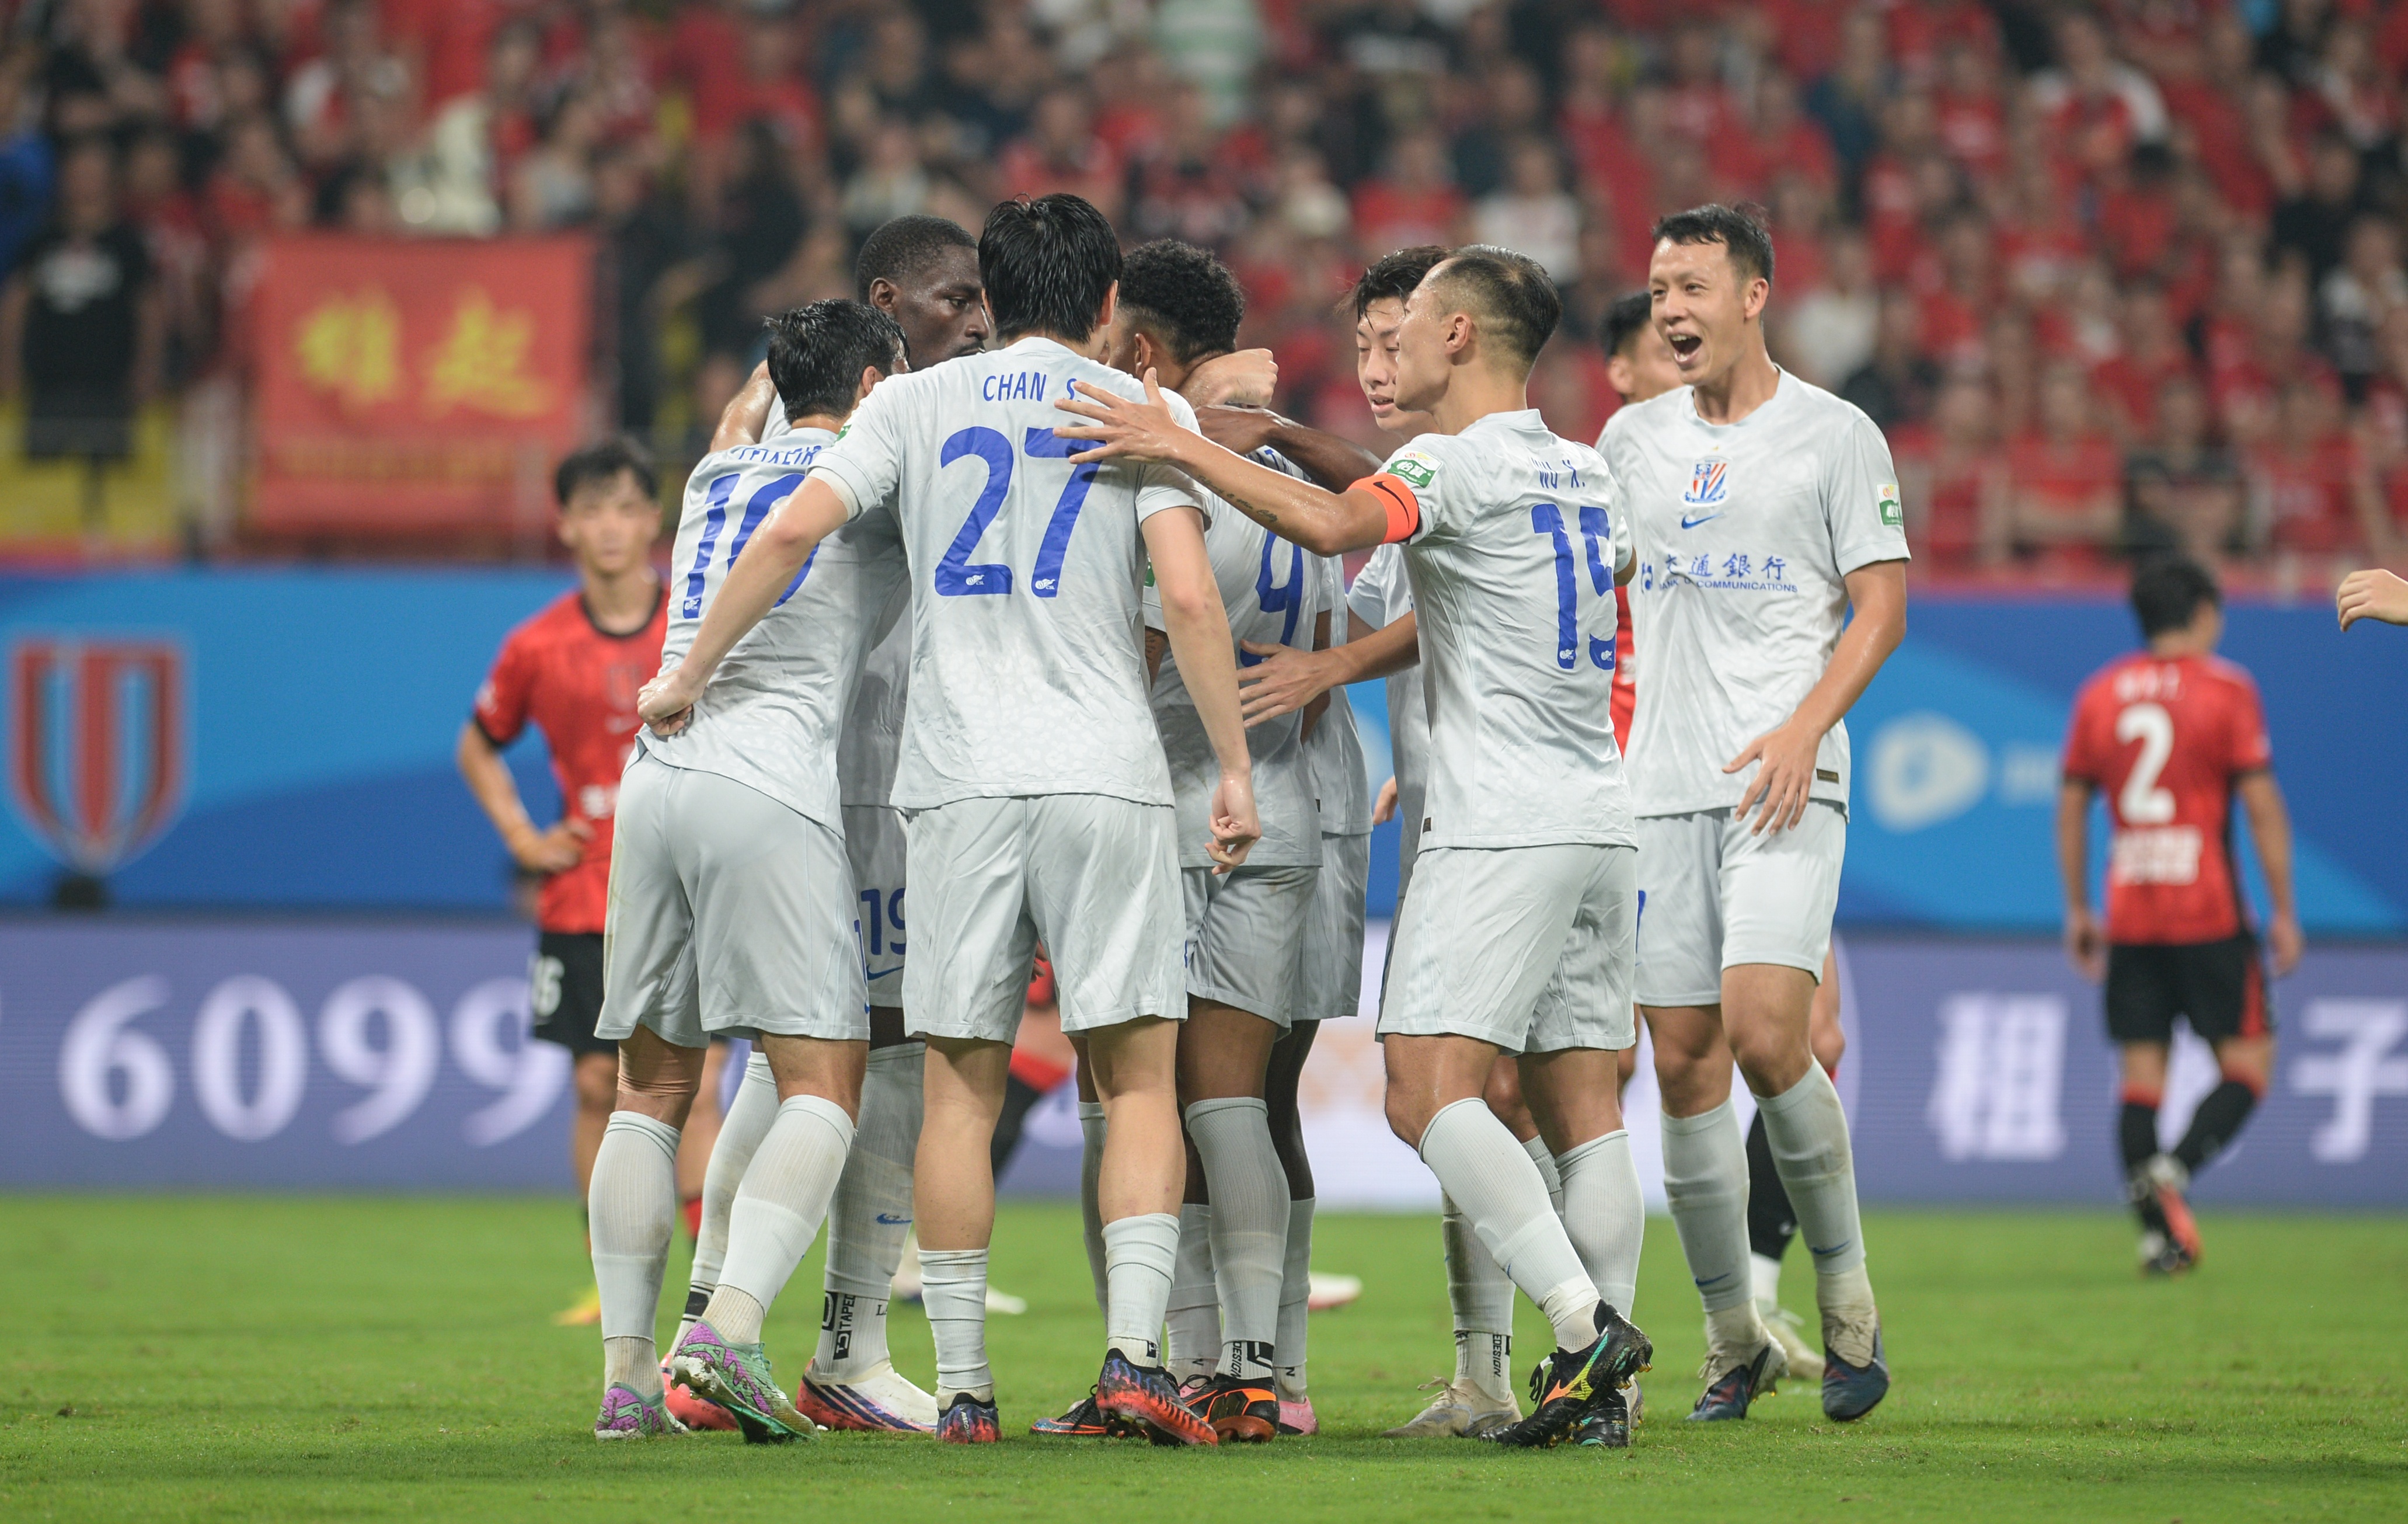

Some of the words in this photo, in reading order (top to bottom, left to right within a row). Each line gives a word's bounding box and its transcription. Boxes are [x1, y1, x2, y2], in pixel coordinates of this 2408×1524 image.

[983, 371, 1047, 402] CHAN
[935, 426, 1107, 597] 27
[1531, 457, 1557, 489] WU
[1531, 503, 1616, 670] 15
[1696, 580, 1798, 593] COMMUNICATIONS
[2116, 704, 2176, 824] 2
[1929, 994, 2408, 1161] 租子
